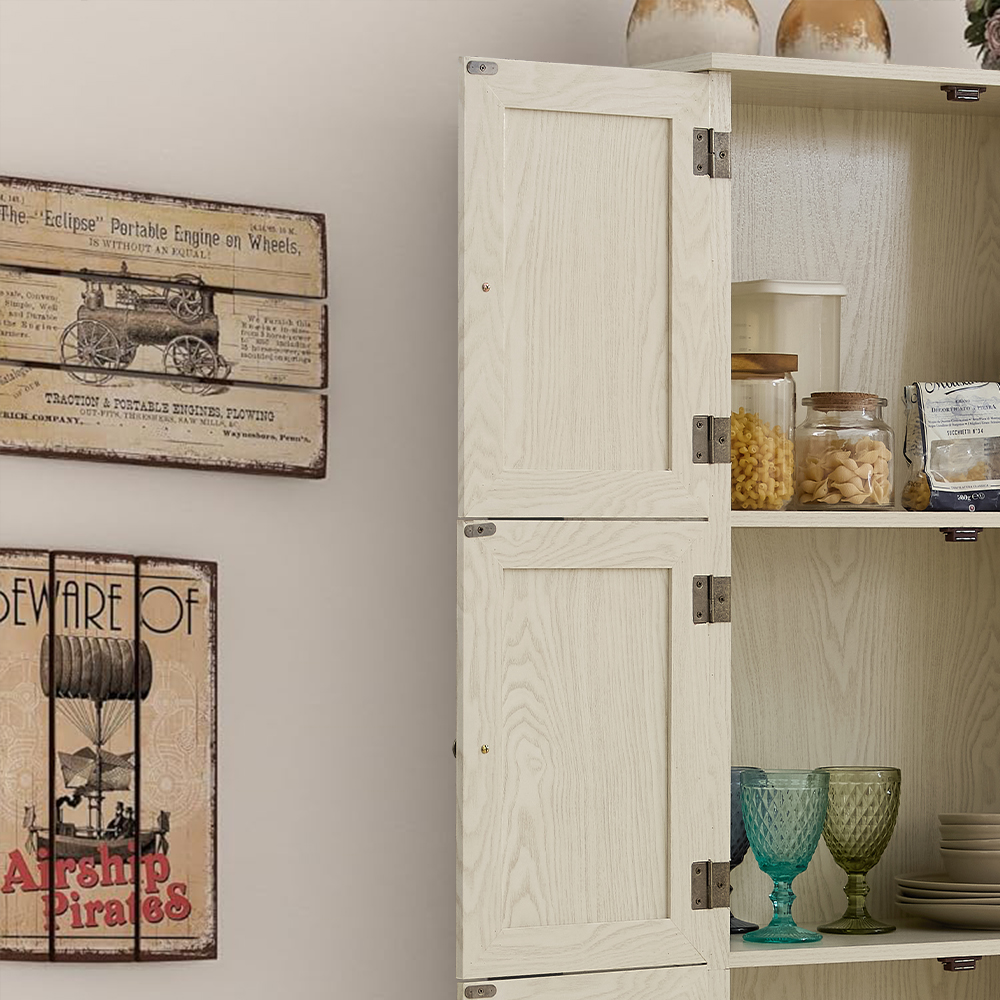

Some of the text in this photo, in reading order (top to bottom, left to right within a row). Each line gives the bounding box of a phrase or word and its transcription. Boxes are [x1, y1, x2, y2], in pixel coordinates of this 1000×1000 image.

[89, 237, 212, 260] IS WITHOUT AN EQUAL!
[111, 216, 168, 240] Portable
[174, 224, 221, 248] Engine
[226, 234, 242, 251] on
[248, 232, 301, 257] Wheels,
[45, 392, 275, 422] TRACTION & PORTABLE ENGINES, PLOWING
[141, 585, 199, 635] OF
[1, 842, 171, 895] Airship
[42, 881, 192, 931] Pirates
